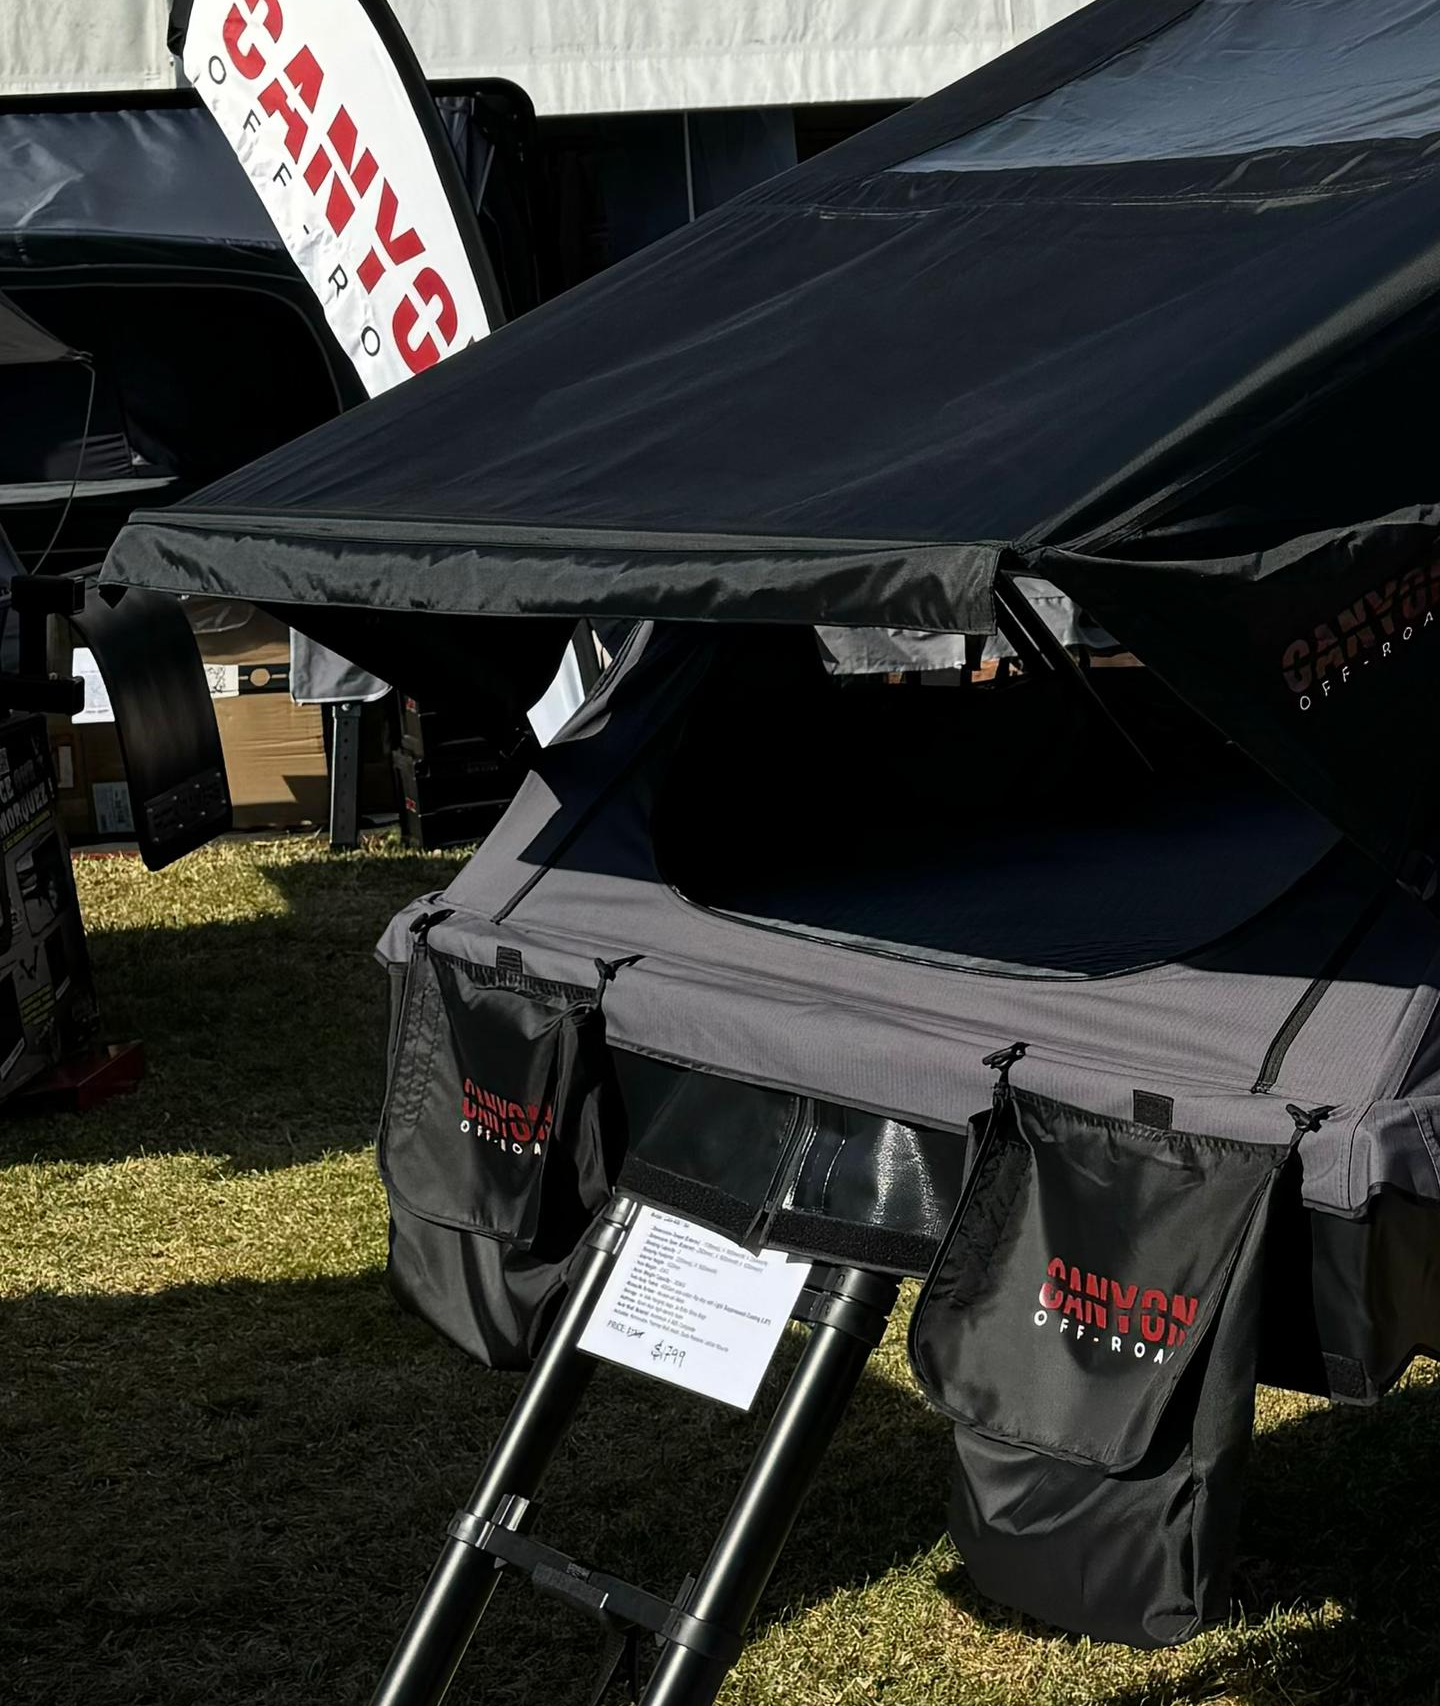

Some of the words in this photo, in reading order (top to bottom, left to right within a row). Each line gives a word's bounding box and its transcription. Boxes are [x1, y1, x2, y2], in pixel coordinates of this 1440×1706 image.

[208, 55, 382, 357] OFF-RO
[1033, 1309, 1175, 1364] OFF-ROA
[1039, 1256, 1199, 1347] CANYON
